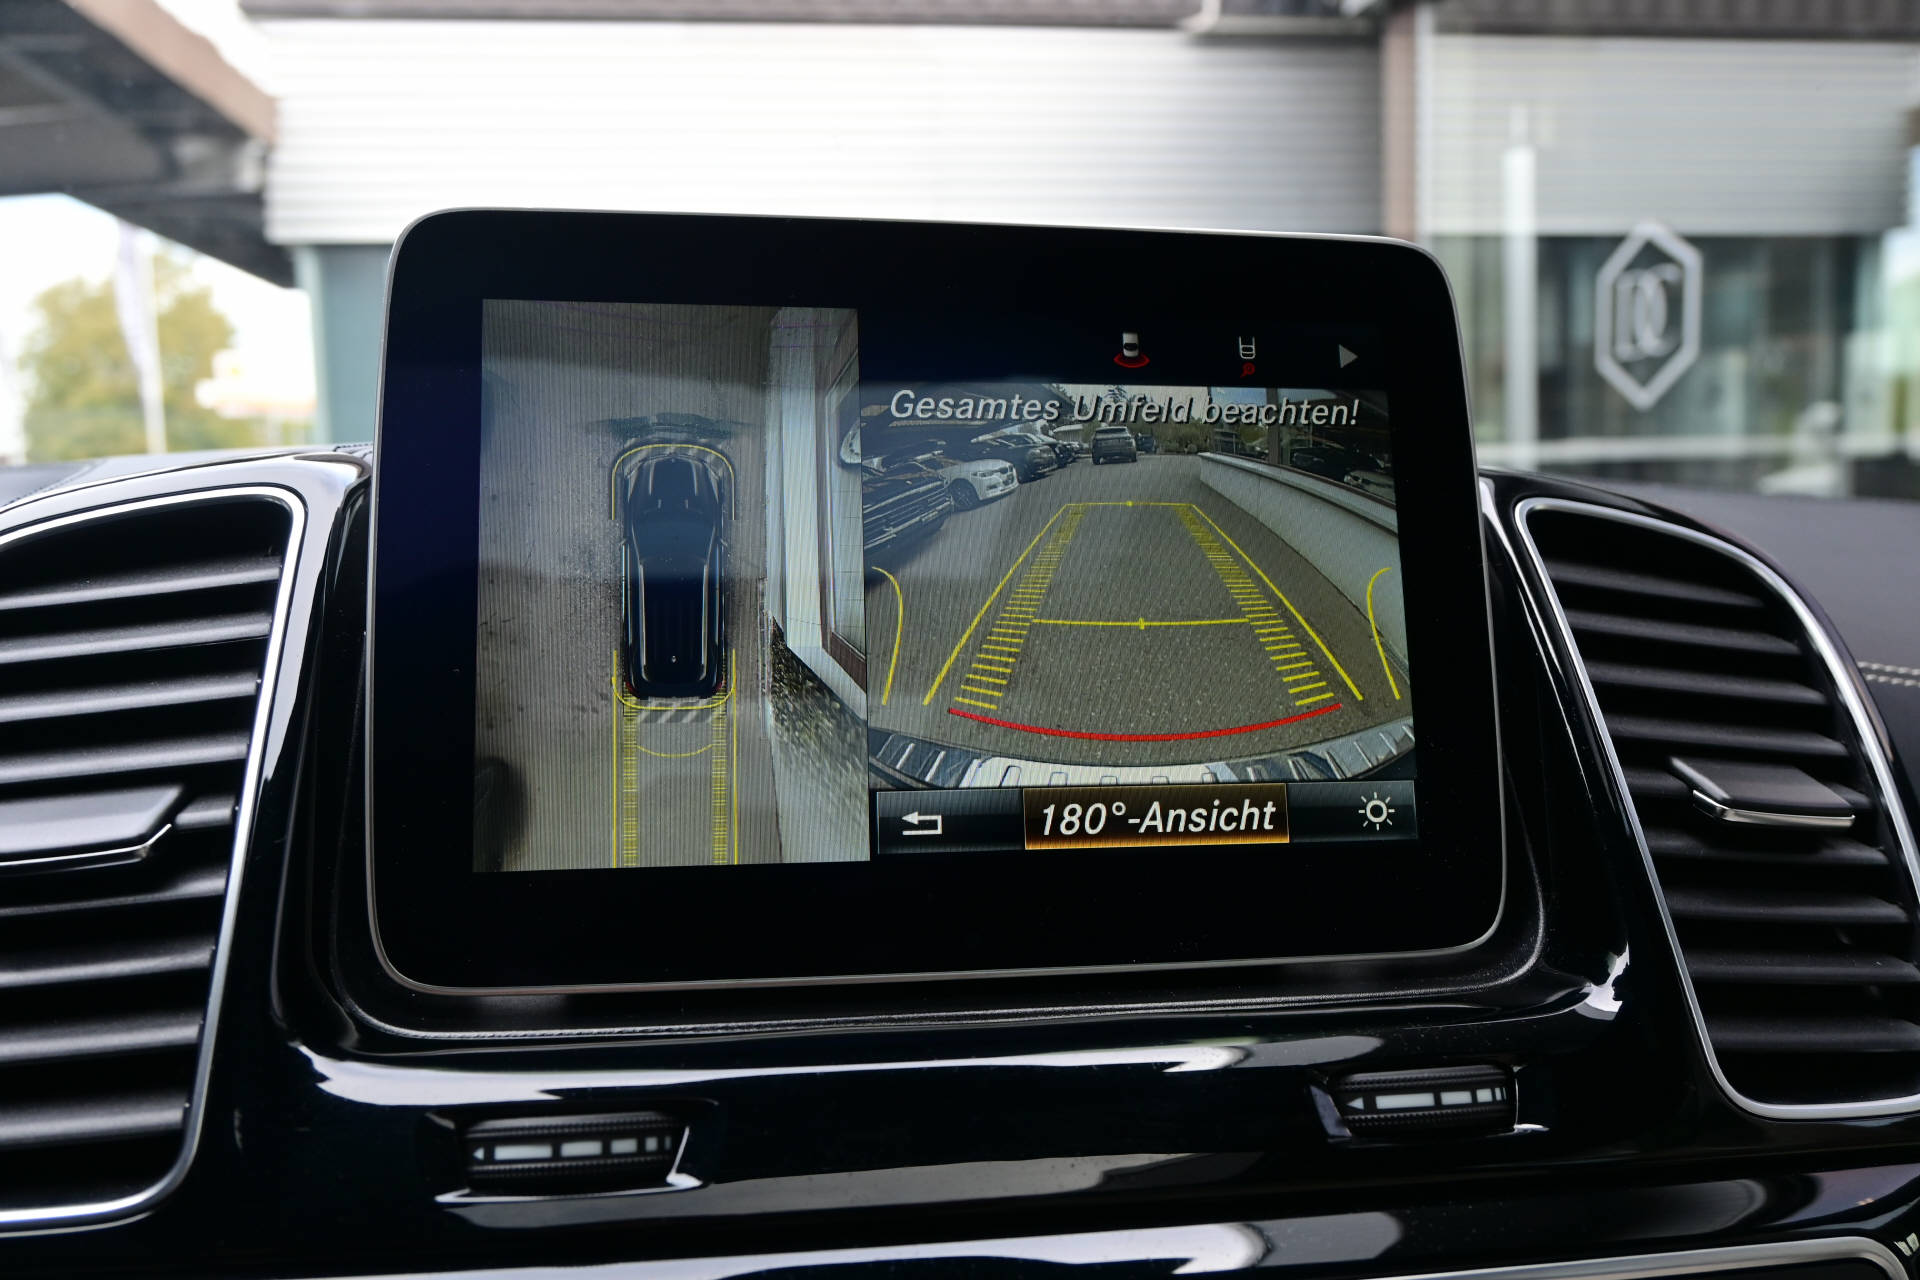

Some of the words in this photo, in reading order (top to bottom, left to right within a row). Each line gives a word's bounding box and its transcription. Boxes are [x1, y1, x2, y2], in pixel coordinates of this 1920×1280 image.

[889, 388, 1060, 421] Gesamtes
[1073, 393, 1192, 424] Umfeld
[1201, 394, 1361, 426] beachten!
[1042, 798, 1277, 836] 180°-Ansicht
